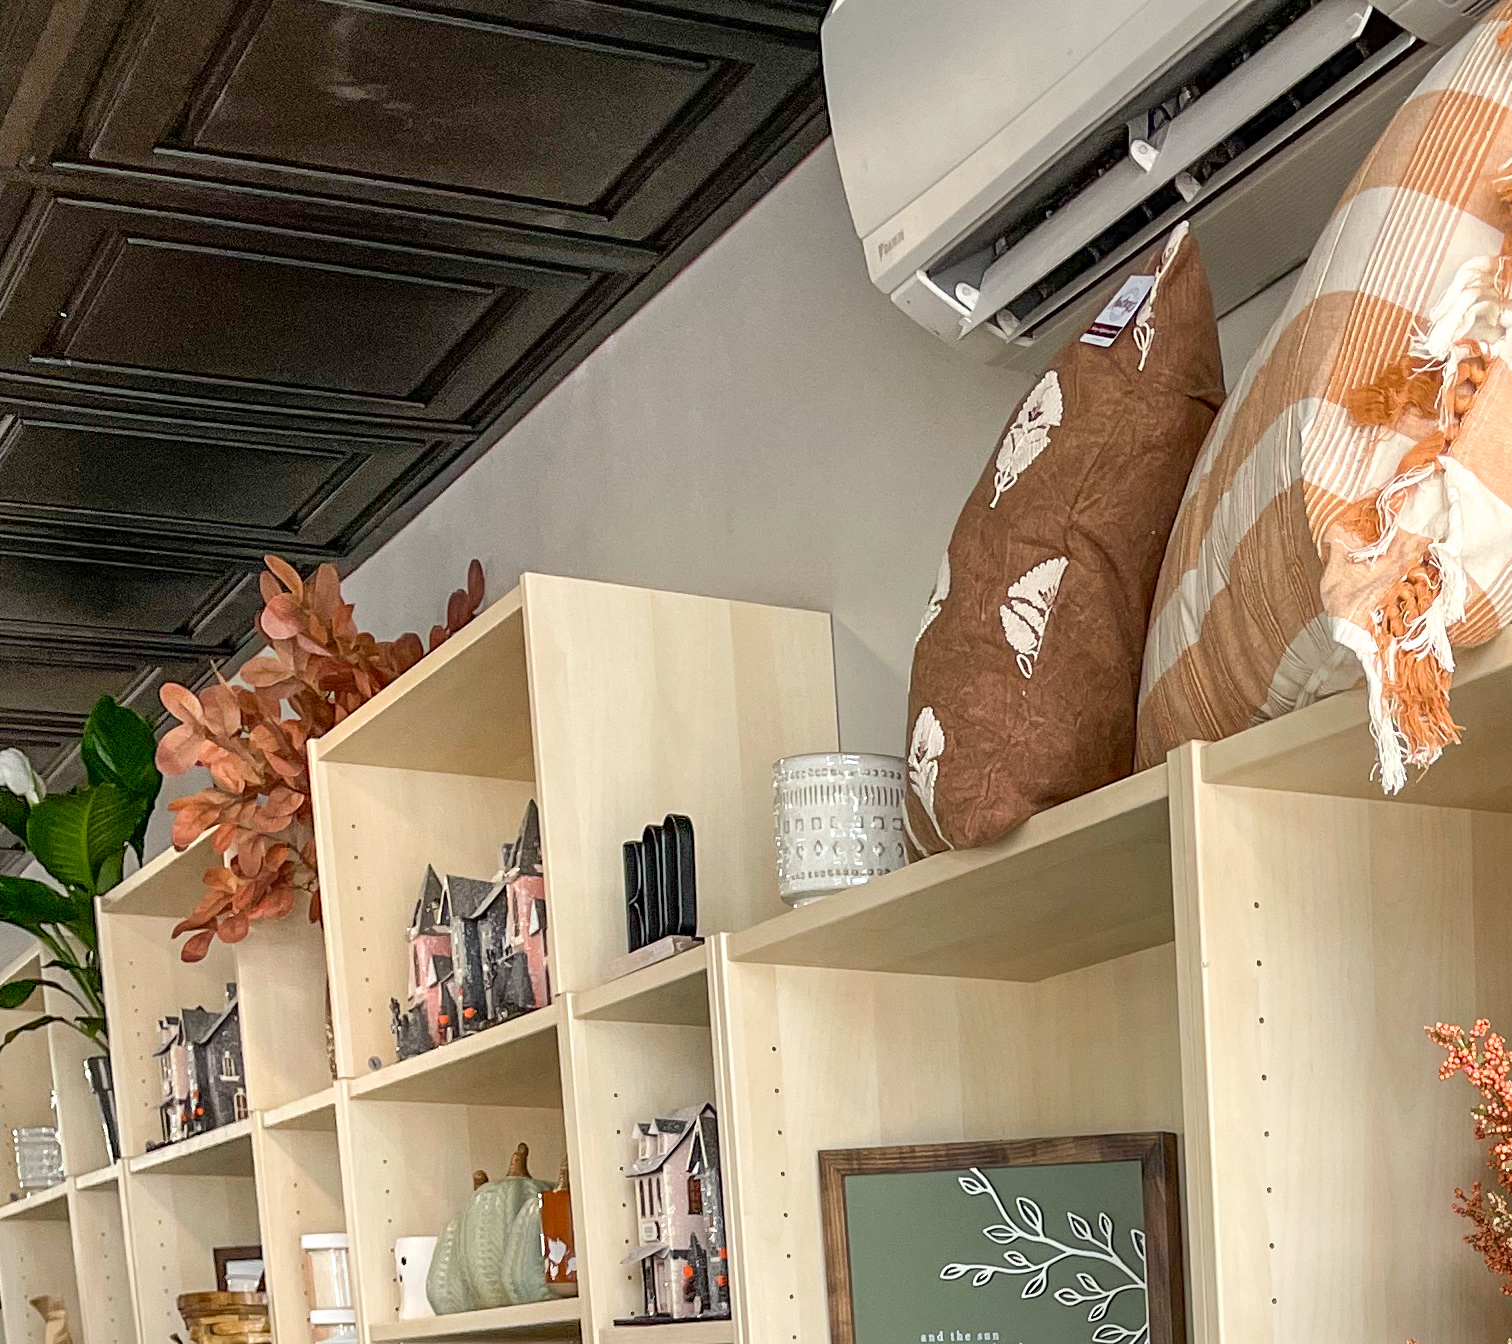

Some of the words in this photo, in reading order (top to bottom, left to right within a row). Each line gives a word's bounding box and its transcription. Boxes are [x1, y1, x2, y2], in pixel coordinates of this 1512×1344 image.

[921, 1331, 944, 1343] and
[950, 1330, 971, 1342] the
[977, 1331, 1000, 1342] sun
